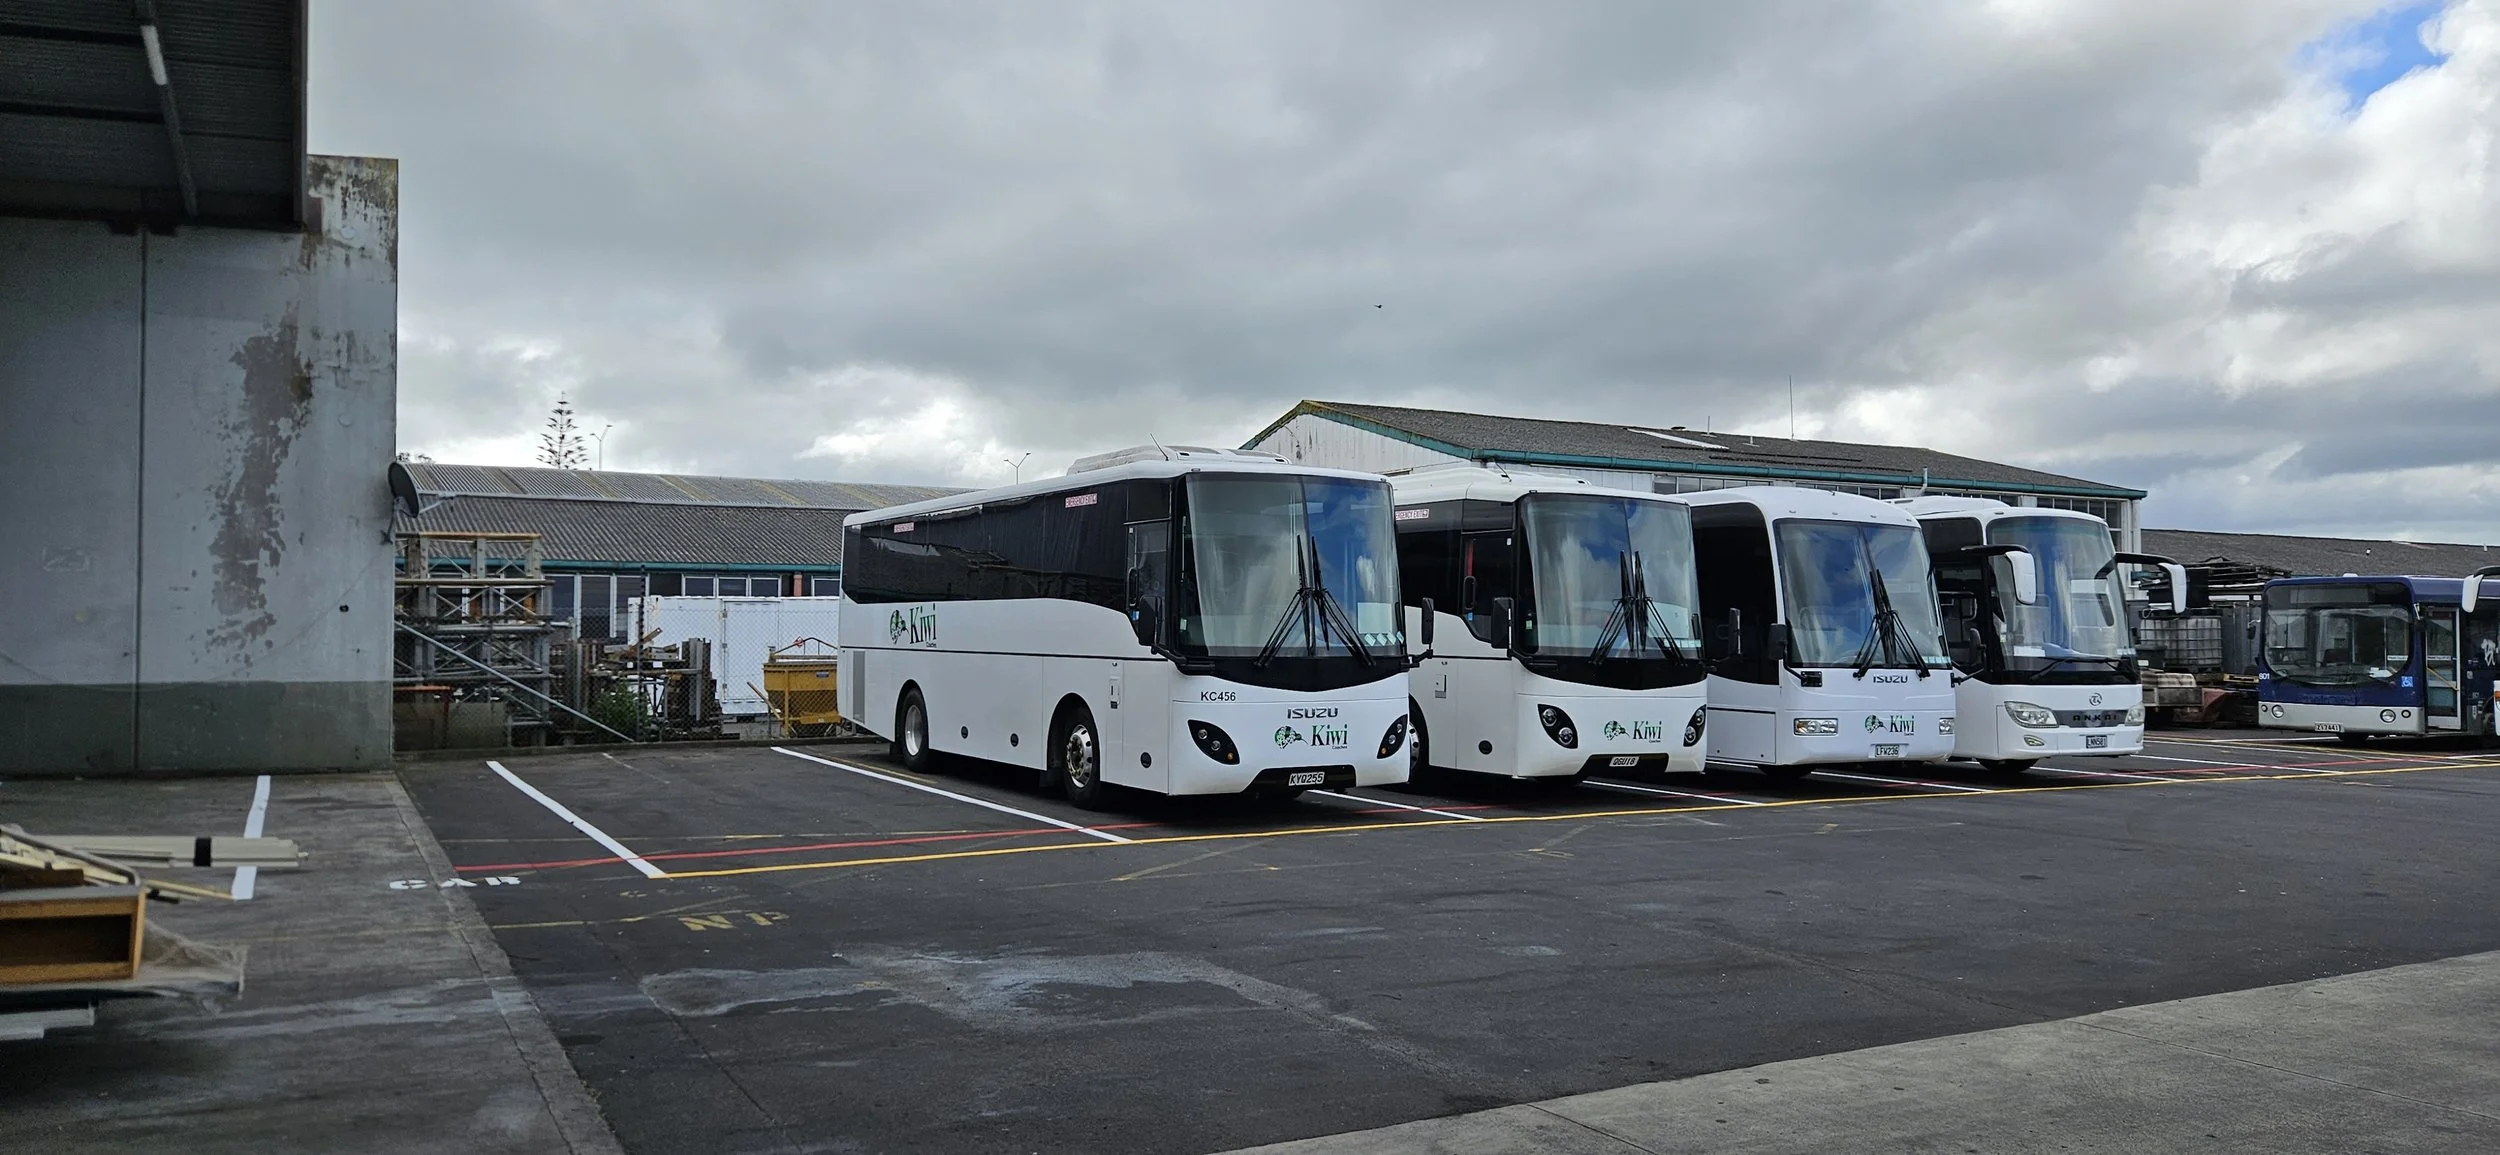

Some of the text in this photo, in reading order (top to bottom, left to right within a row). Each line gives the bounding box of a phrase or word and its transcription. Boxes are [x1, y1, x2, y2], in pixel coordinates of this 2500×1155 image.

[910, 603, 936, 644] Kiwi
[1873, 675, 1908, 683] ISUZU
[1200, 691, 1236, 701] KC456
[1287, 708, 1338, 719] ISUZU
[1633, 720, 1662, 740] Kiwi
[1890, 715, 1914, 733] Kiwi
[1311, 723, 1348, 746] Kiwi
[1290, 773, 1324, 784] KYQ255
[389, 876, 520, 889] CAR
